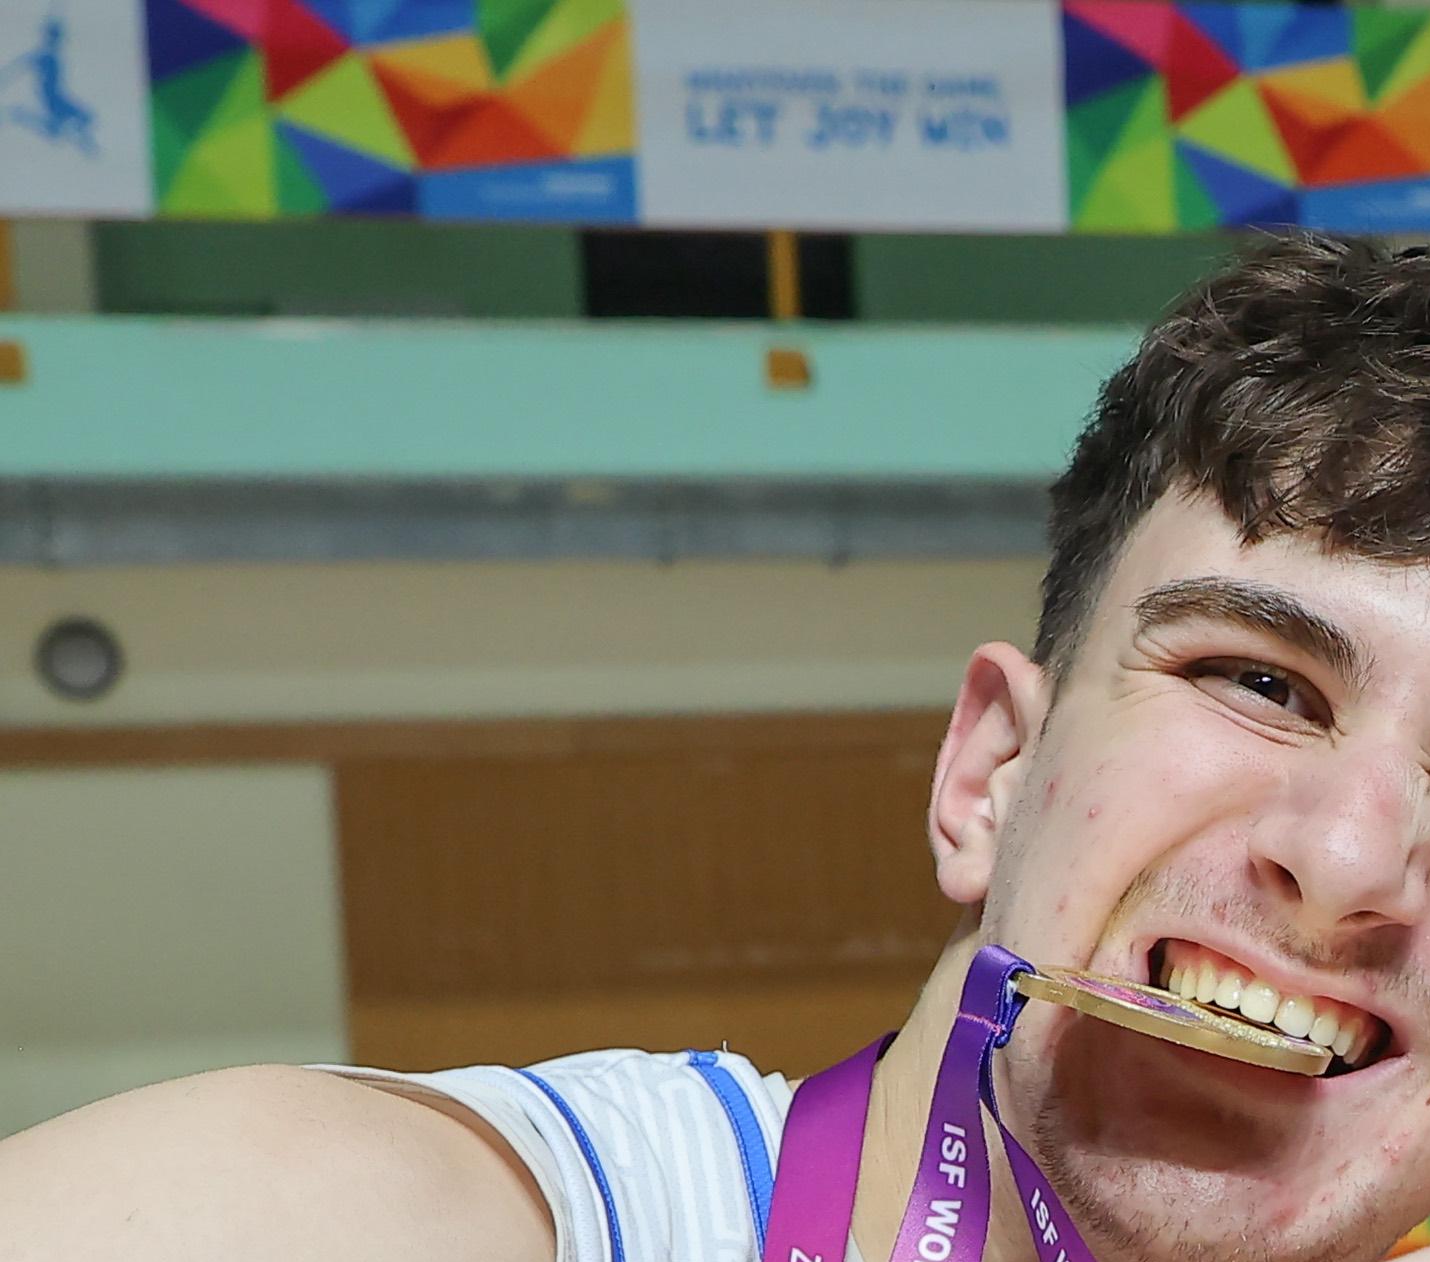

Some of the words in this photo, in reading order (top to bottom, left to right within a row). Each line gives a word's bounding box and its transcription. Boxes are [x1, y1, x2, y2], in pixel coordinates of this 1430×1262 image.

[687, 102, 777, 147] LET
[806, 106, 893, 148] JOY
[922, 110, 1010, 149] WIN
[940, 1121, 967, 1189] ISF
[1029, 1188, 1059, 1247] ISF
